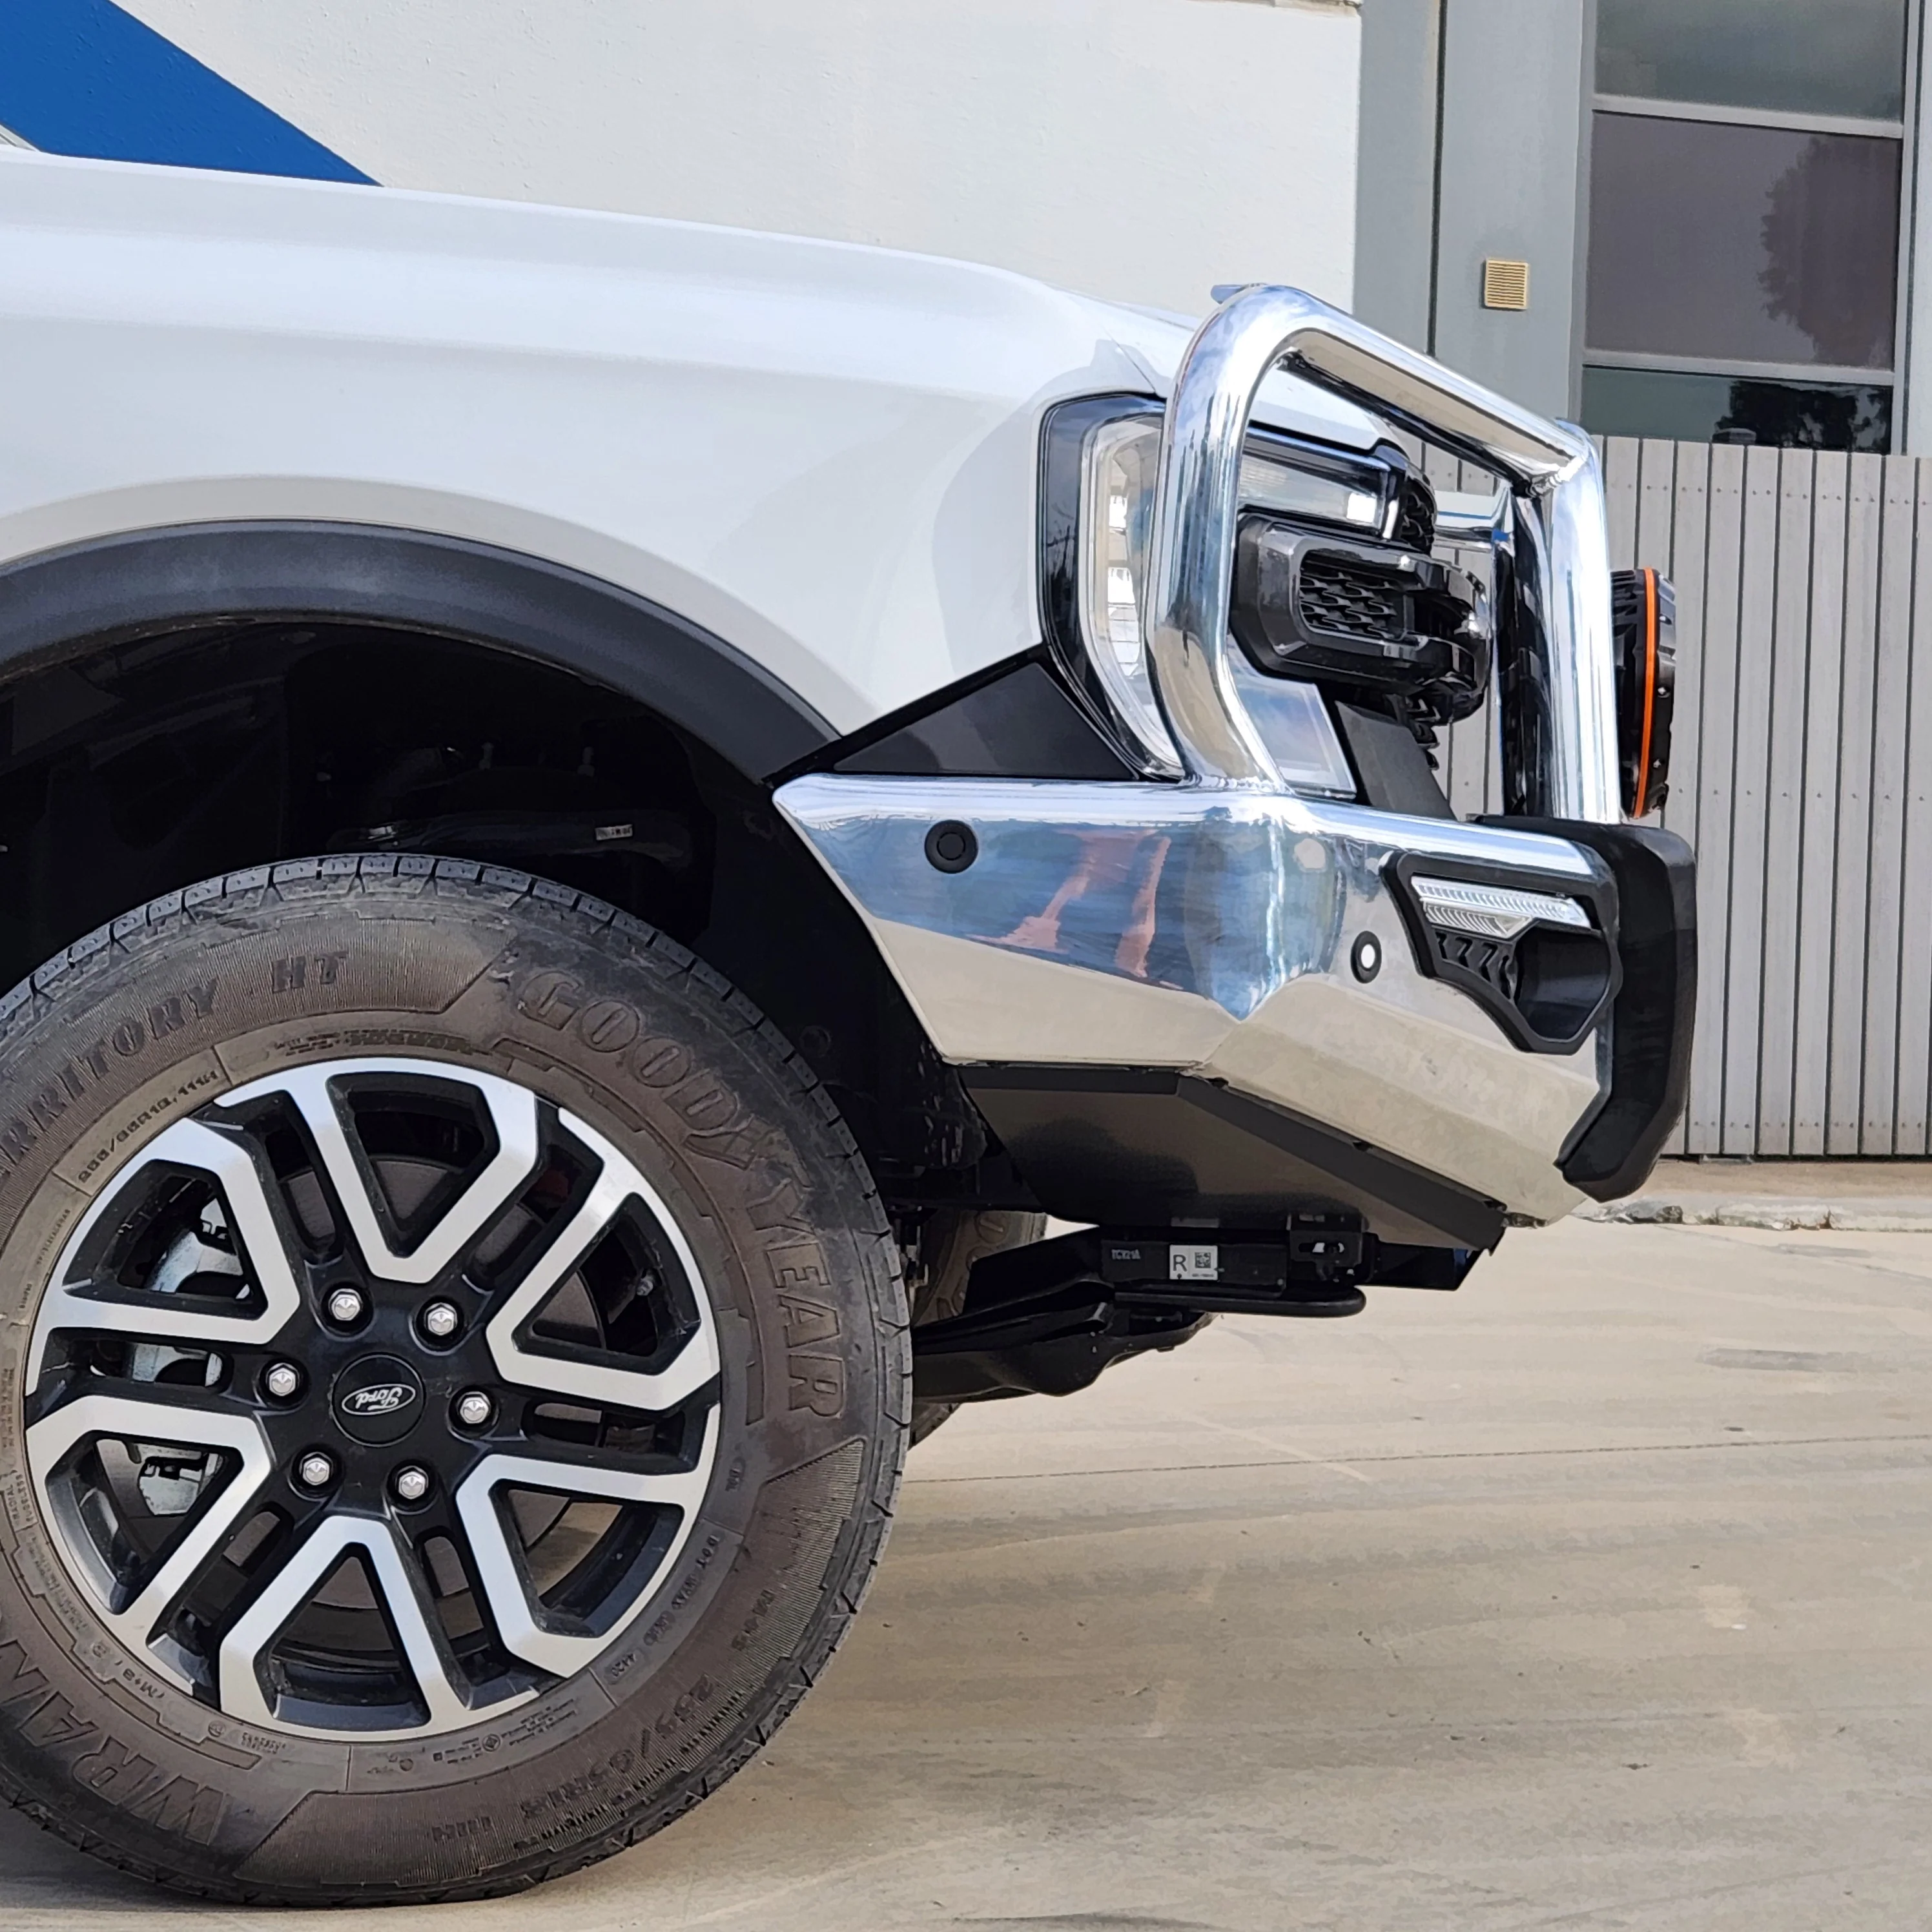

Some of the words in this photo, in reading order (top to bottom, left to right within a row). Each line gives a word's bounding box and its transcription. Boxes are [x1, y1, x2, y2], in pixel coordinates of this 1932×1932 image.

[0, 978, 218, 1186] RRITORY
[271, 951, 348, 993] HT
[520, 970, 845, 1419] GOODYEAR
[1173, 1254, 1187, 1272] R
[355, 1387, 402, 1410] Ford
